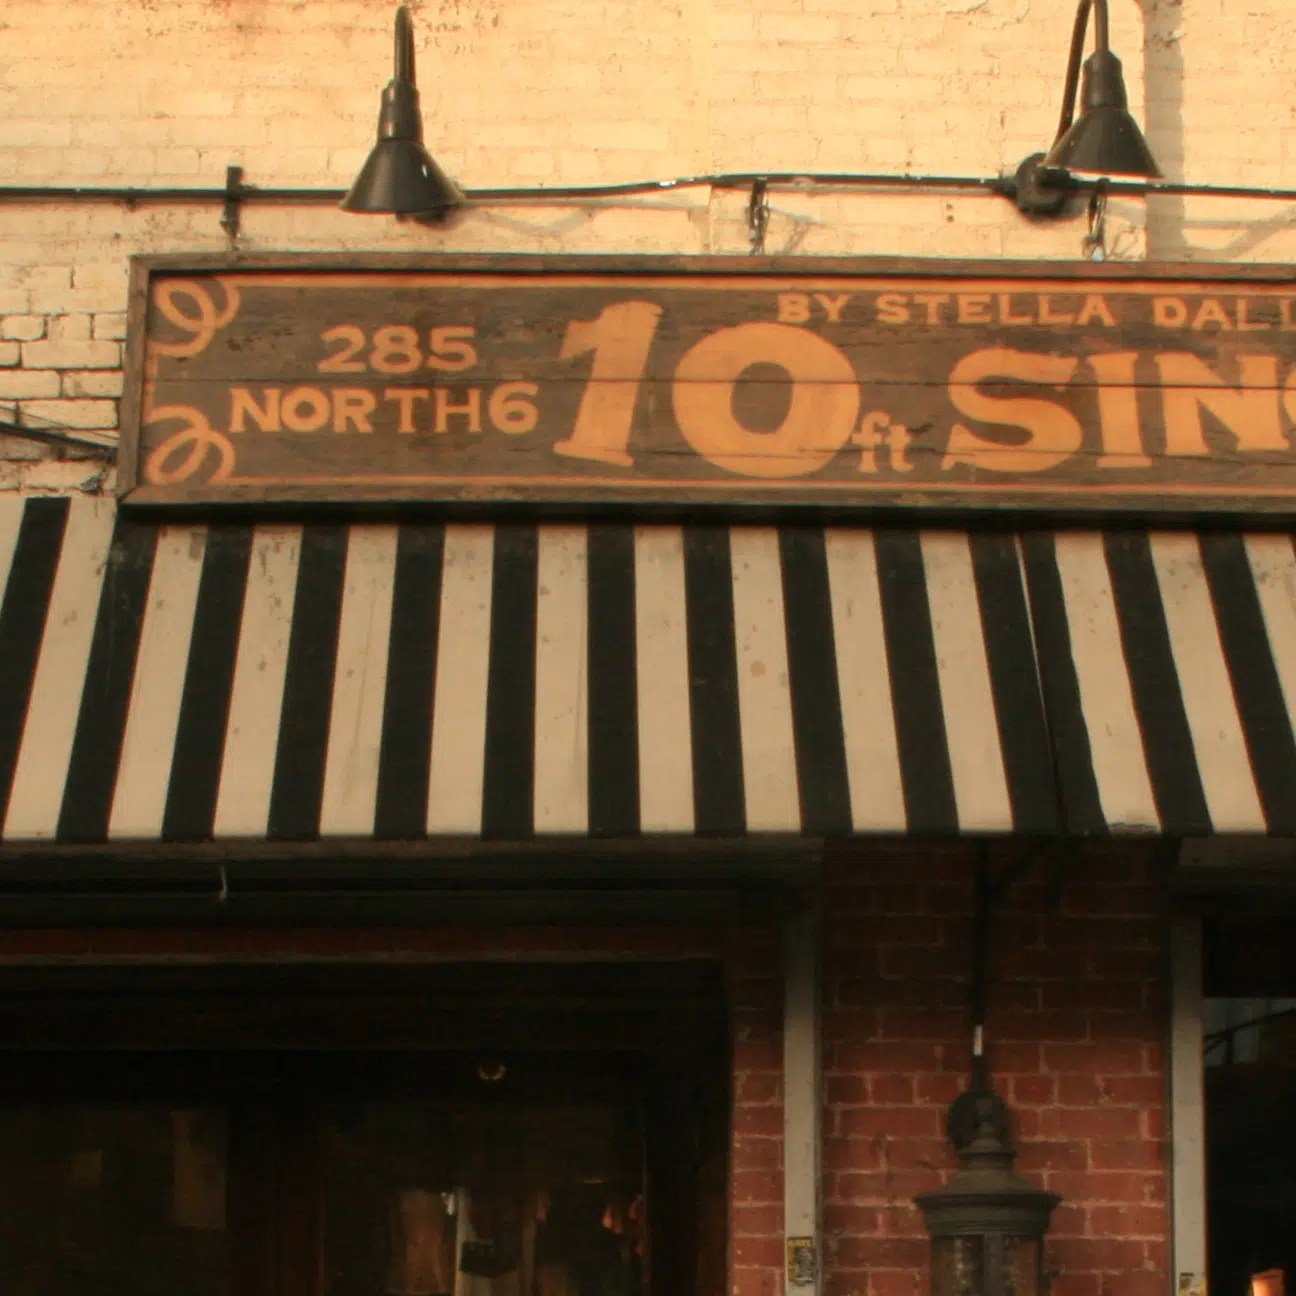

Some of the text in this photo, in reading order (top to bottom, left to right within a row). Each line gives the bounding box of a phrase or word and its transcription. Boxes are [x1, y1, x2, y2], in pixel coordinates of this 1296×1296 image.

[777, 293, 851, 323] BY
[875, 293, 1116, 327] STELLA
[317, 325, 478, 373] 285
[553, 300, 860, 478] 10
[851, 411, 915, 473] ft
